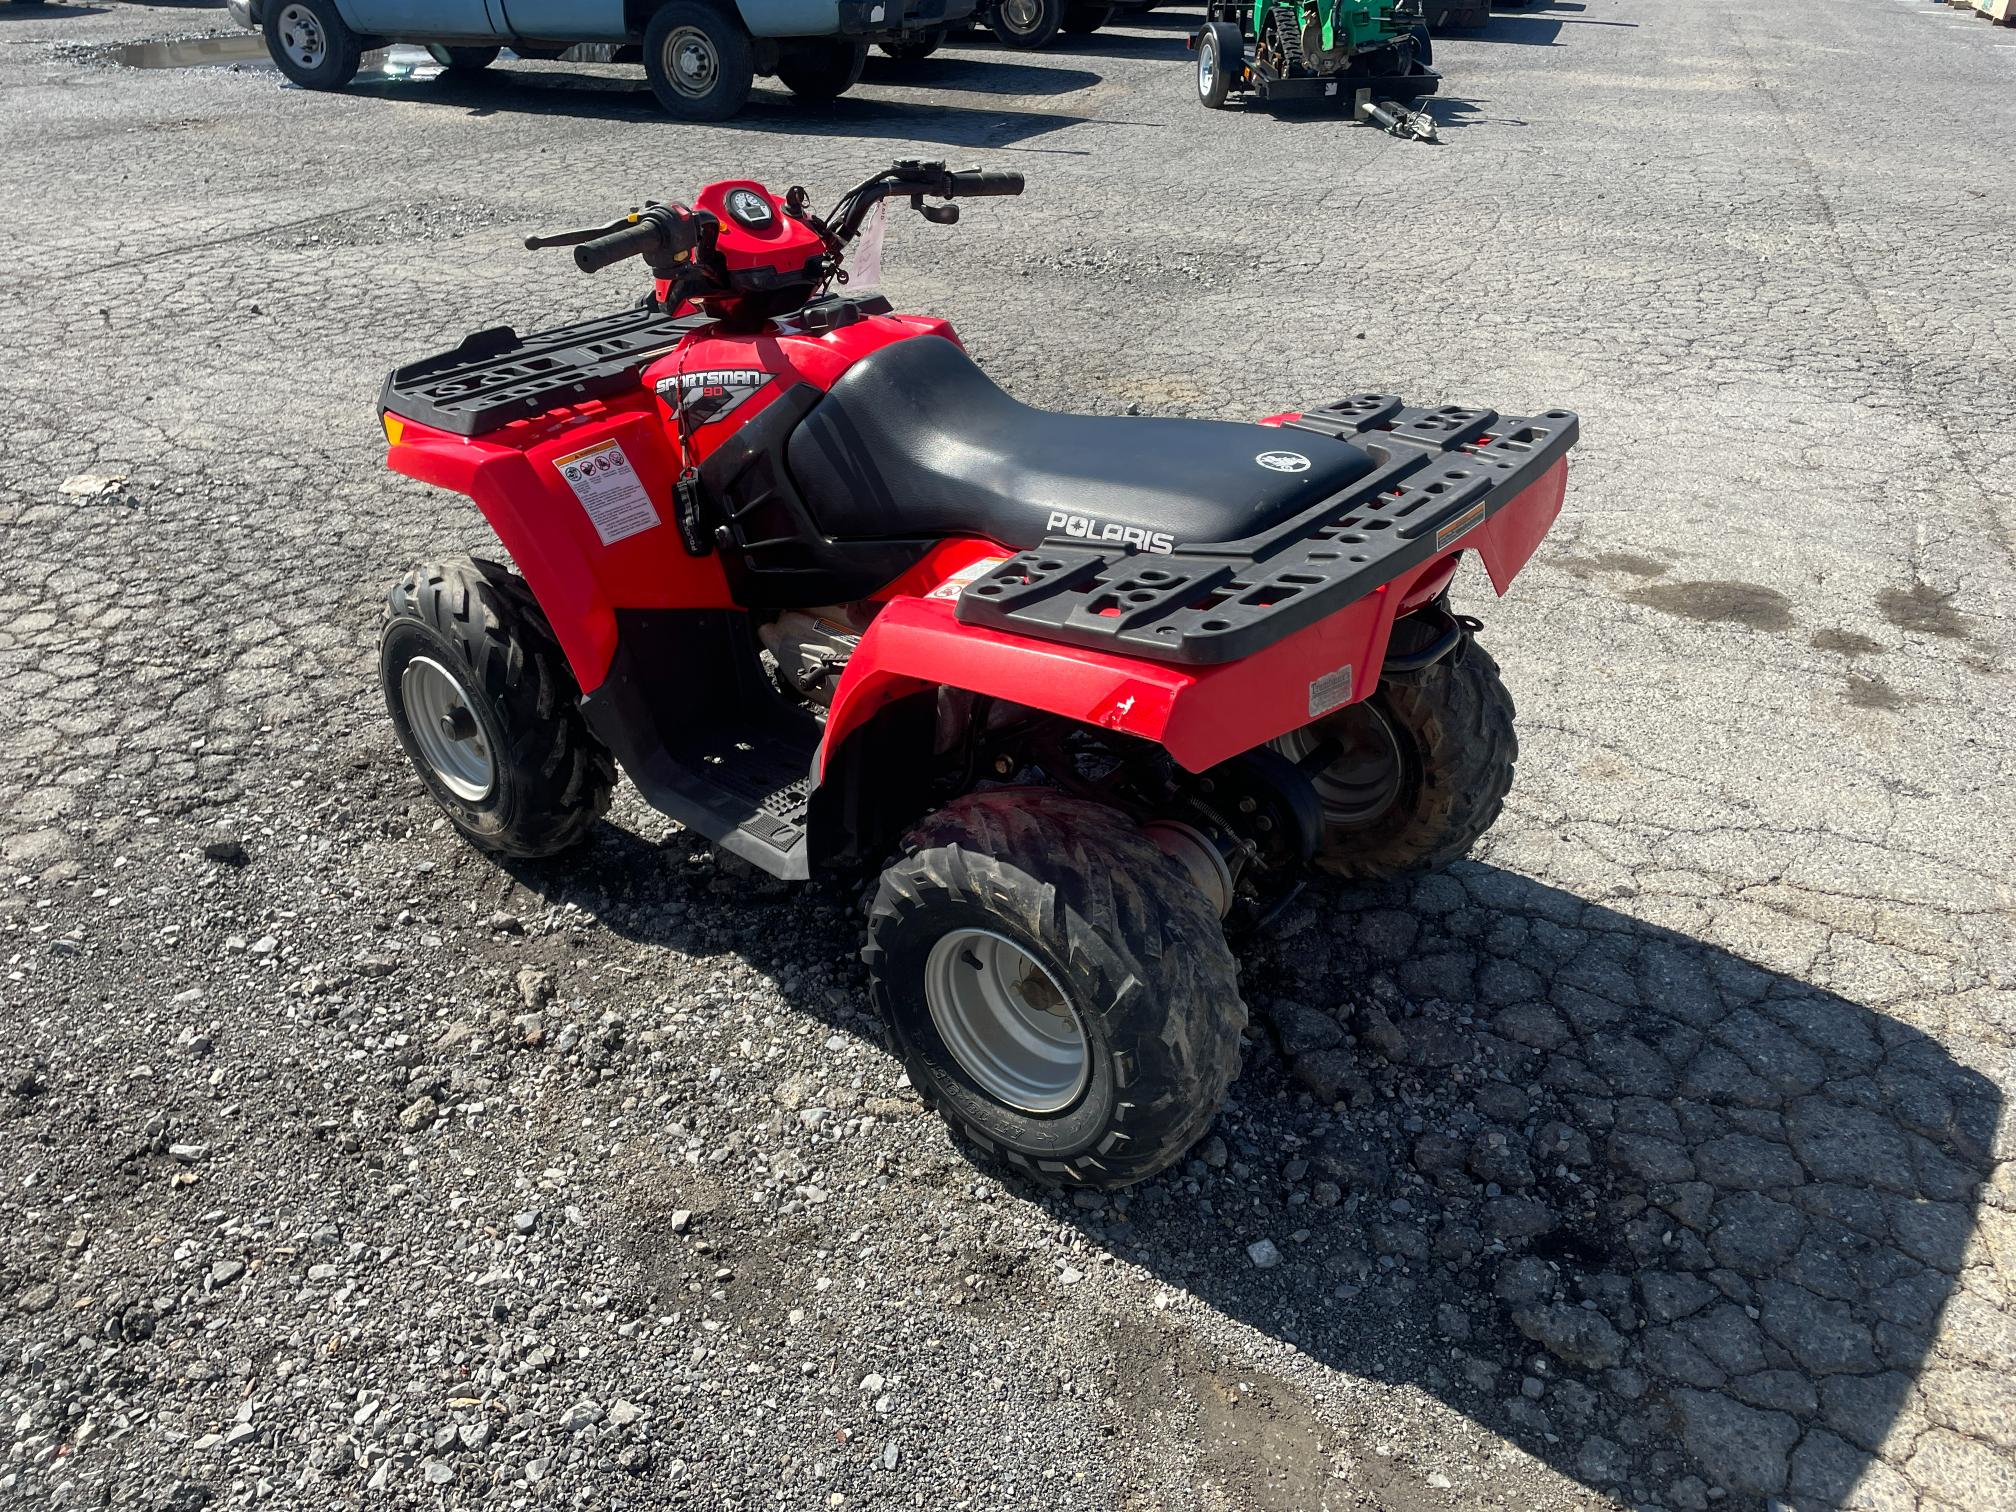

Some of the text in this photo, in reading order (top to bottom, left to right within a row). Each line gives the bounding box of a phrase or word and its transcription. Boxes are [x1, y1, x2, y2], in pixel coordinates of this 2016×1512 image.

[656, 371, 760, 394] SPORTSMAN
[703, 386, 723, 397] 90
[1046, 511, 1175, 555] POLARIS
